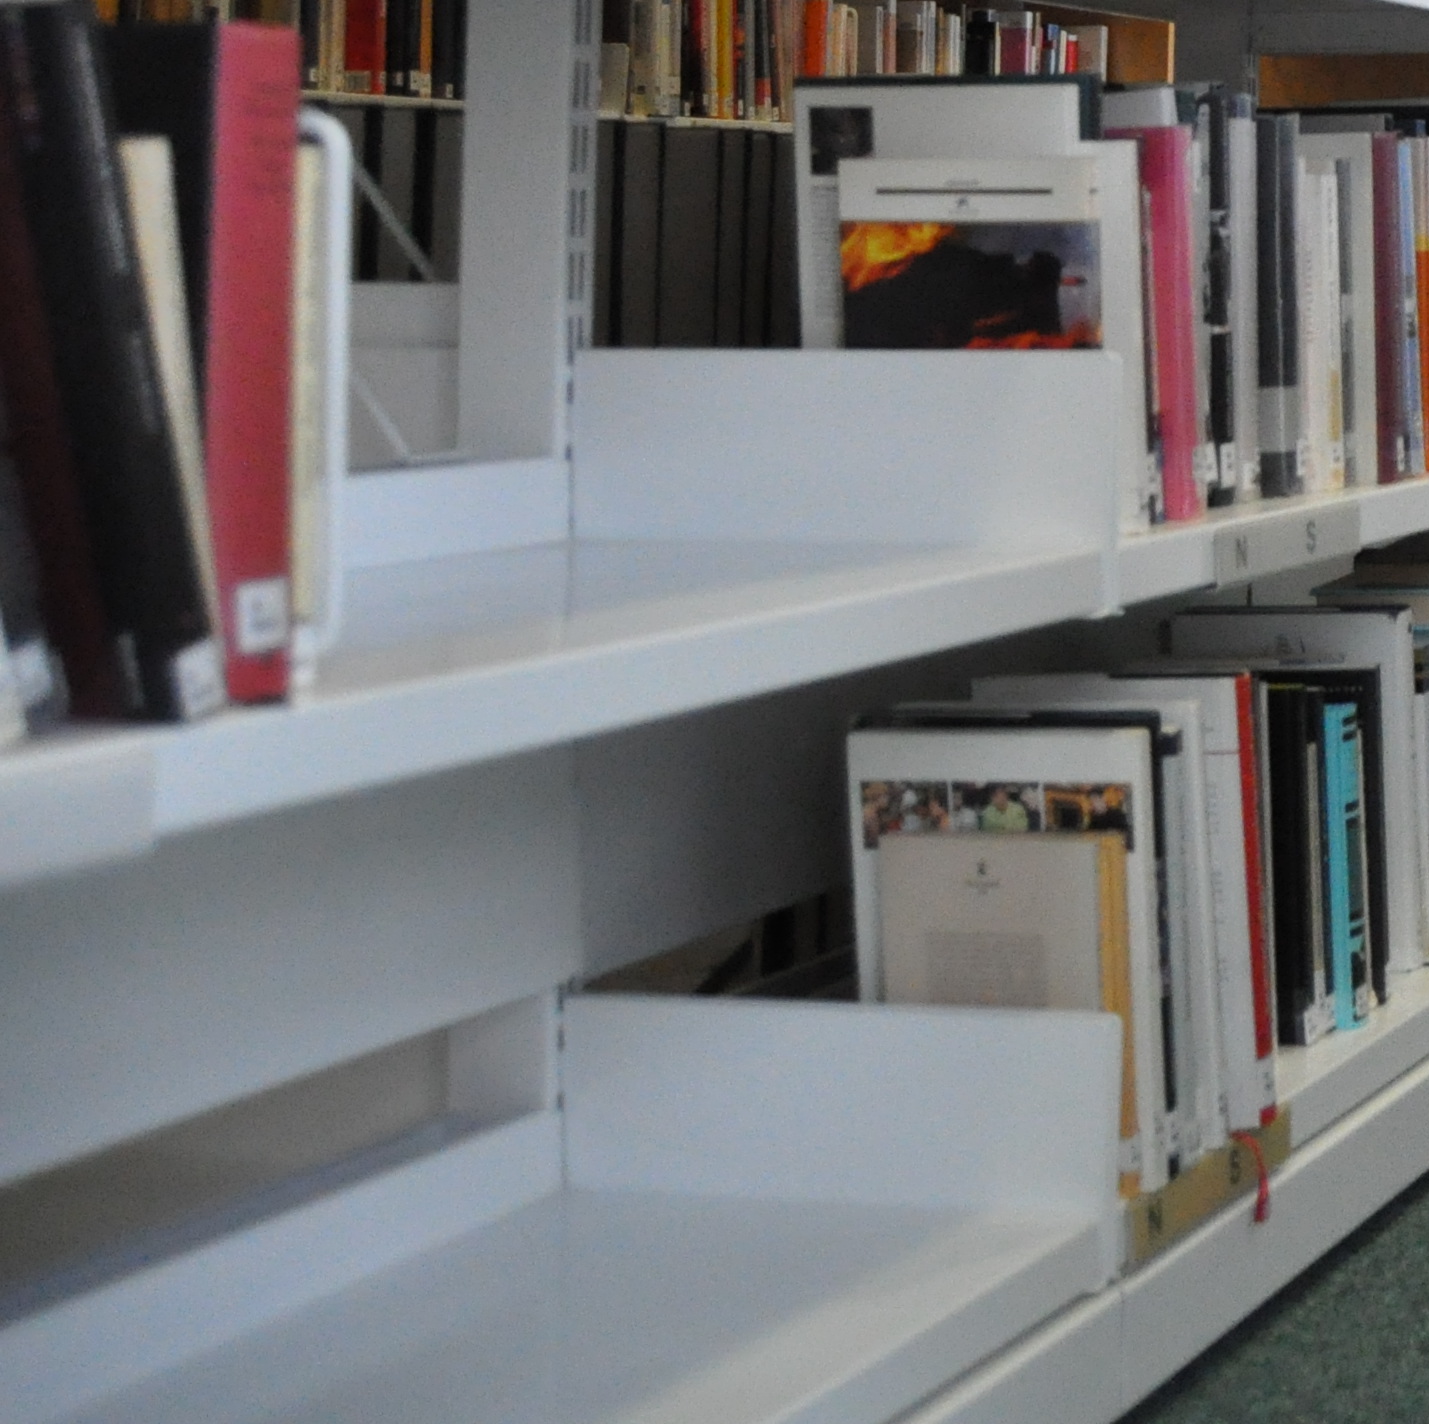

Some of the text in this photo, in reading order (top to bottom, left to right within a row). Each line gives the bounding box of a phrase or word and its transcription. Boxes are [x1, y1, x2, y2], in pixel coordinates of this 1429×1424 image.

[1234, 521, 1318, 569] N S
[1148, 1202, 1164, 1239] N
